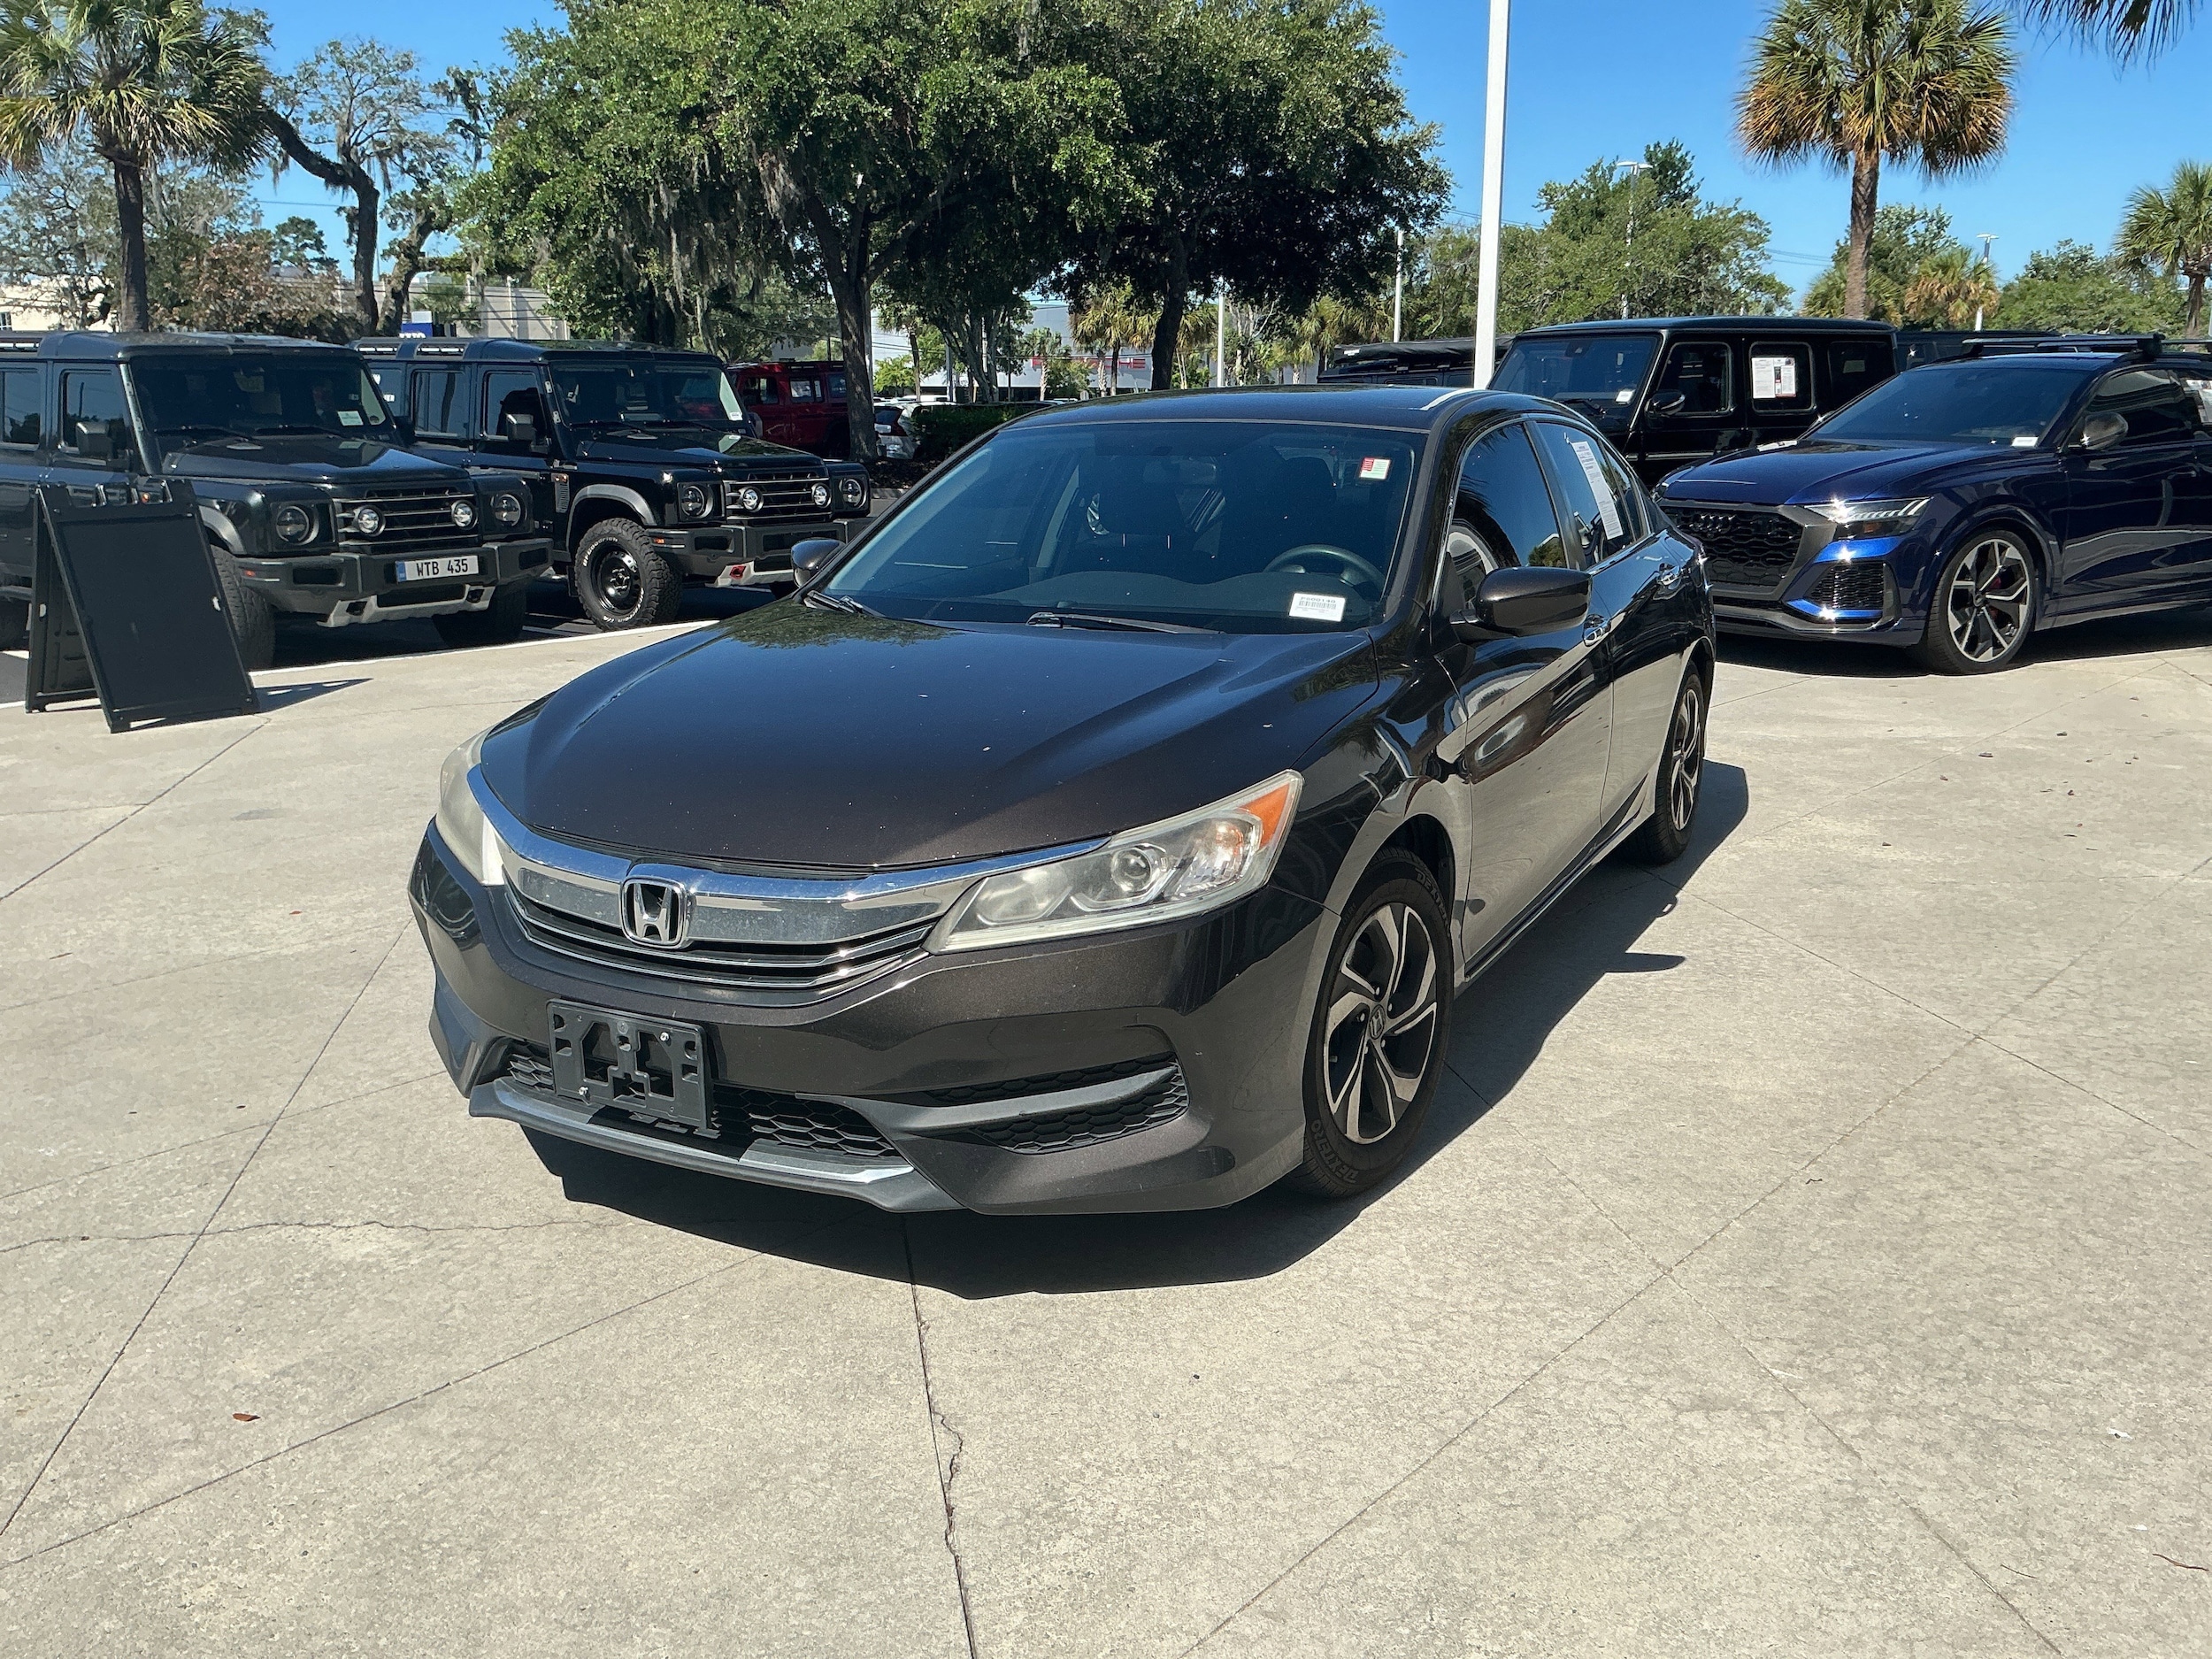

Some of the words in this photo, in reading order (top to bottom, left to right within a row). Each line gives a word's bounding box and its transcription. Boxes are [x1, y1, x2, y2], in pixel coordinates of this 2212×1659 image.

[416, 561, 440, 577] WTB
[447, 558, 468, 574] 435
[1310, 1118, 1360, 1184] DEXTERO
